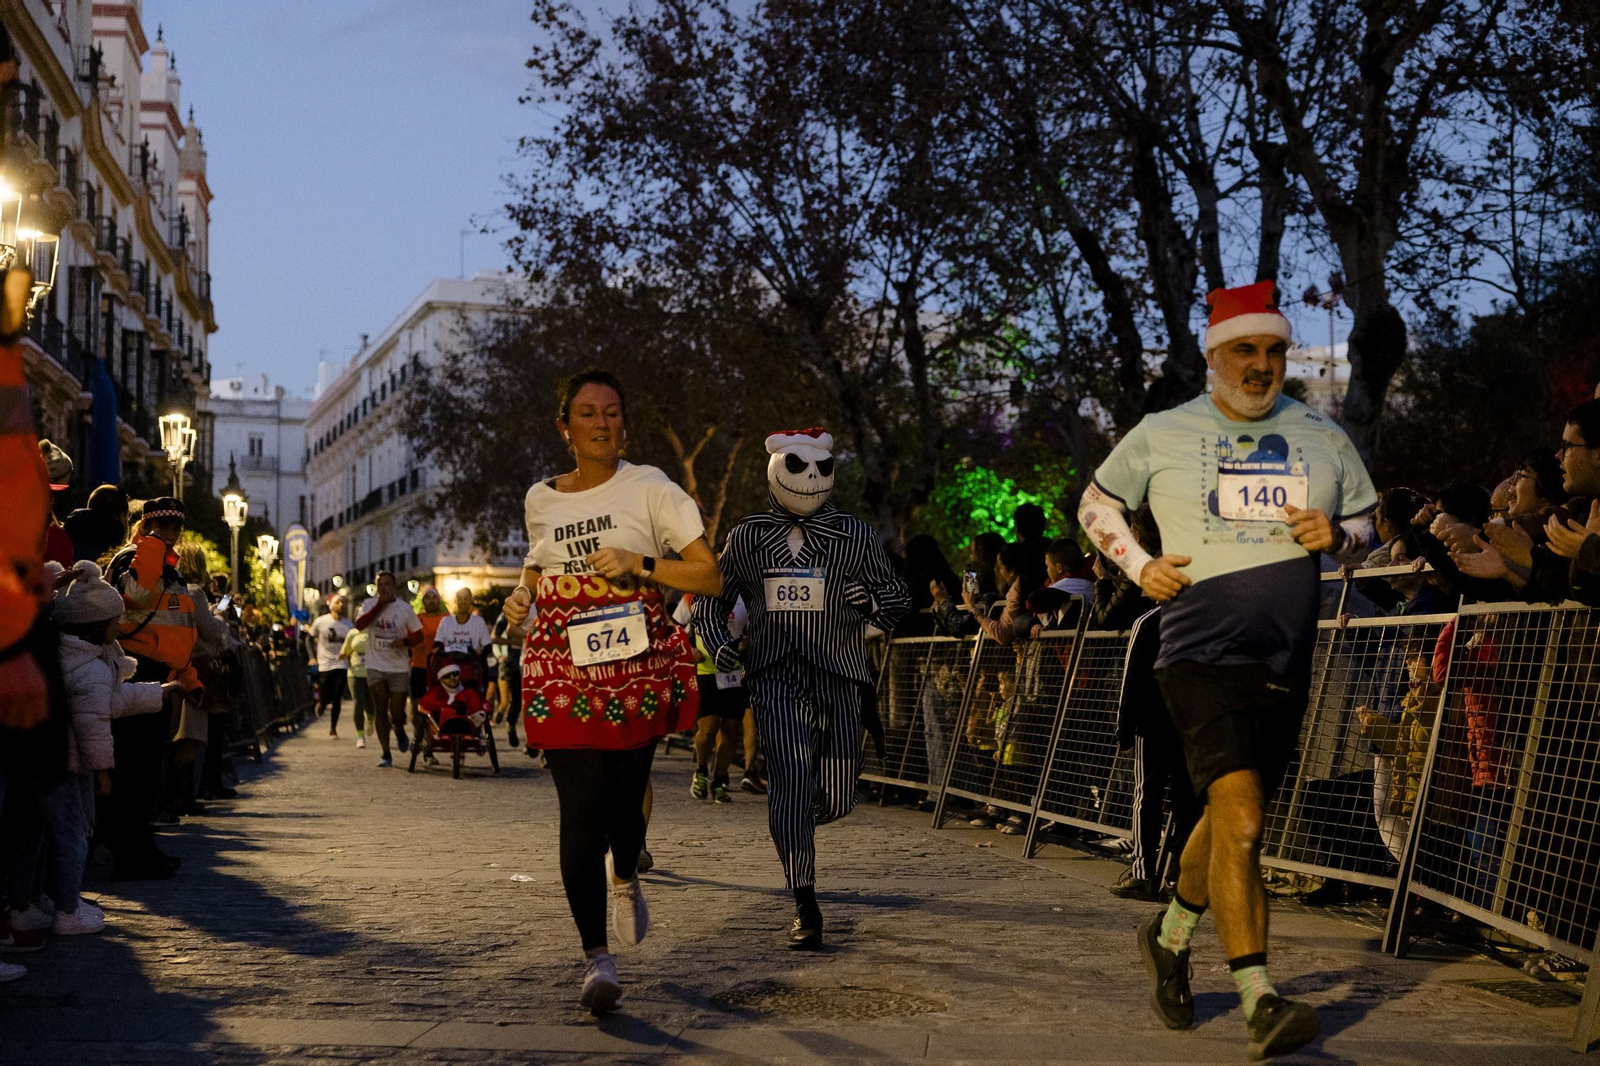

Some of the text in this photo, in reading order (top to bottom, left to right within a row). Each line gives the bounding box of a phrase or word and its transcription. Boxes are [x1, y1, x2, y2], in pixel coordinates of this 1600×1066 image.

[1238, 485, 1287, 507] 140
[554, 514, 617, 542] DREAM.
[777, 584, 811, 601] 683
[587, 627, 631, 652] 674
[522, 660, 553, 678] DON'T
[587, 665, 615, 681] WITH
[621, 660, 643, 675] THE
